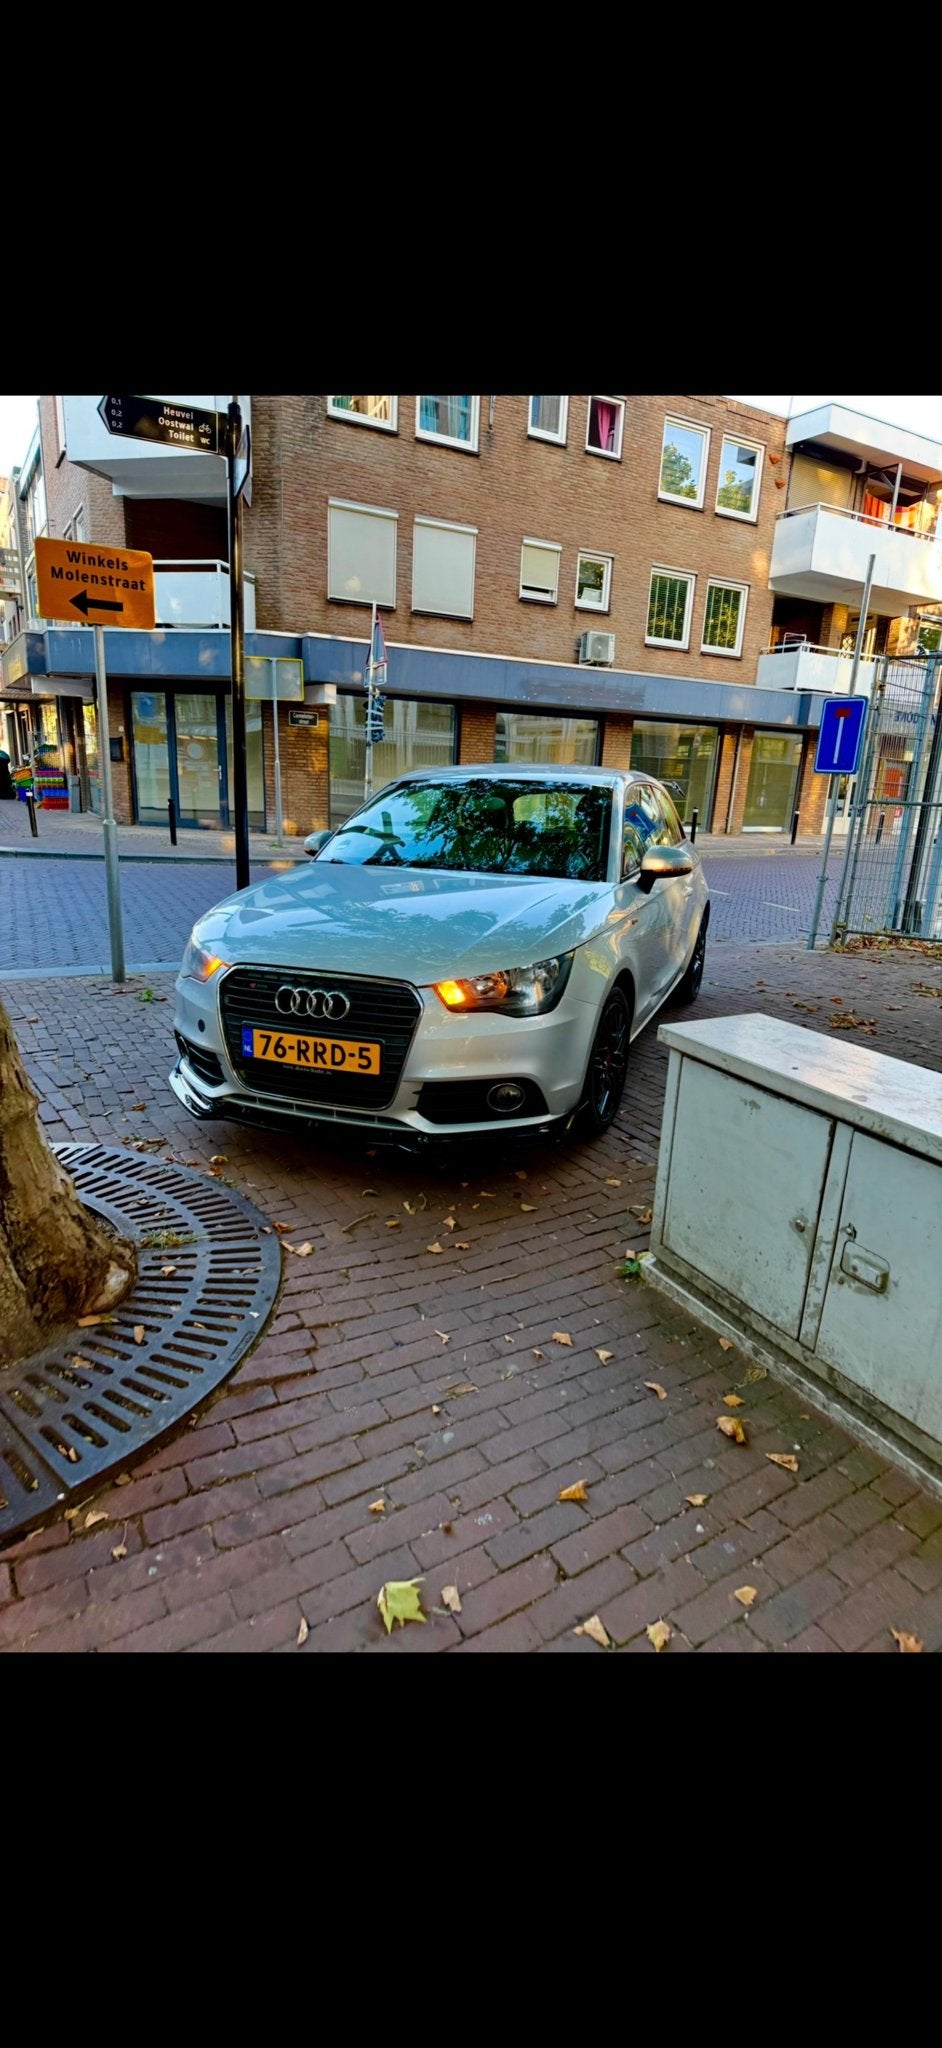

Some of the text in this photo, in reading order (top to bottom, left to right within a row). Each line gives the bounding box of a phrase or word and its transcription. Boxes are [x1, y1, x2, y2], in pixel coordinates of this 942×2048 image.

[163, 406, 194, 420] Heuvel
[158, 416, 194, 431] Oostwal
[168, 429, 194, 442] Toilet
[66, 550, 129, 571] Winkels
[50, 566, 146, 591] Molenstraat
[259, 1034, 372, 1070] 76-RRD-5
